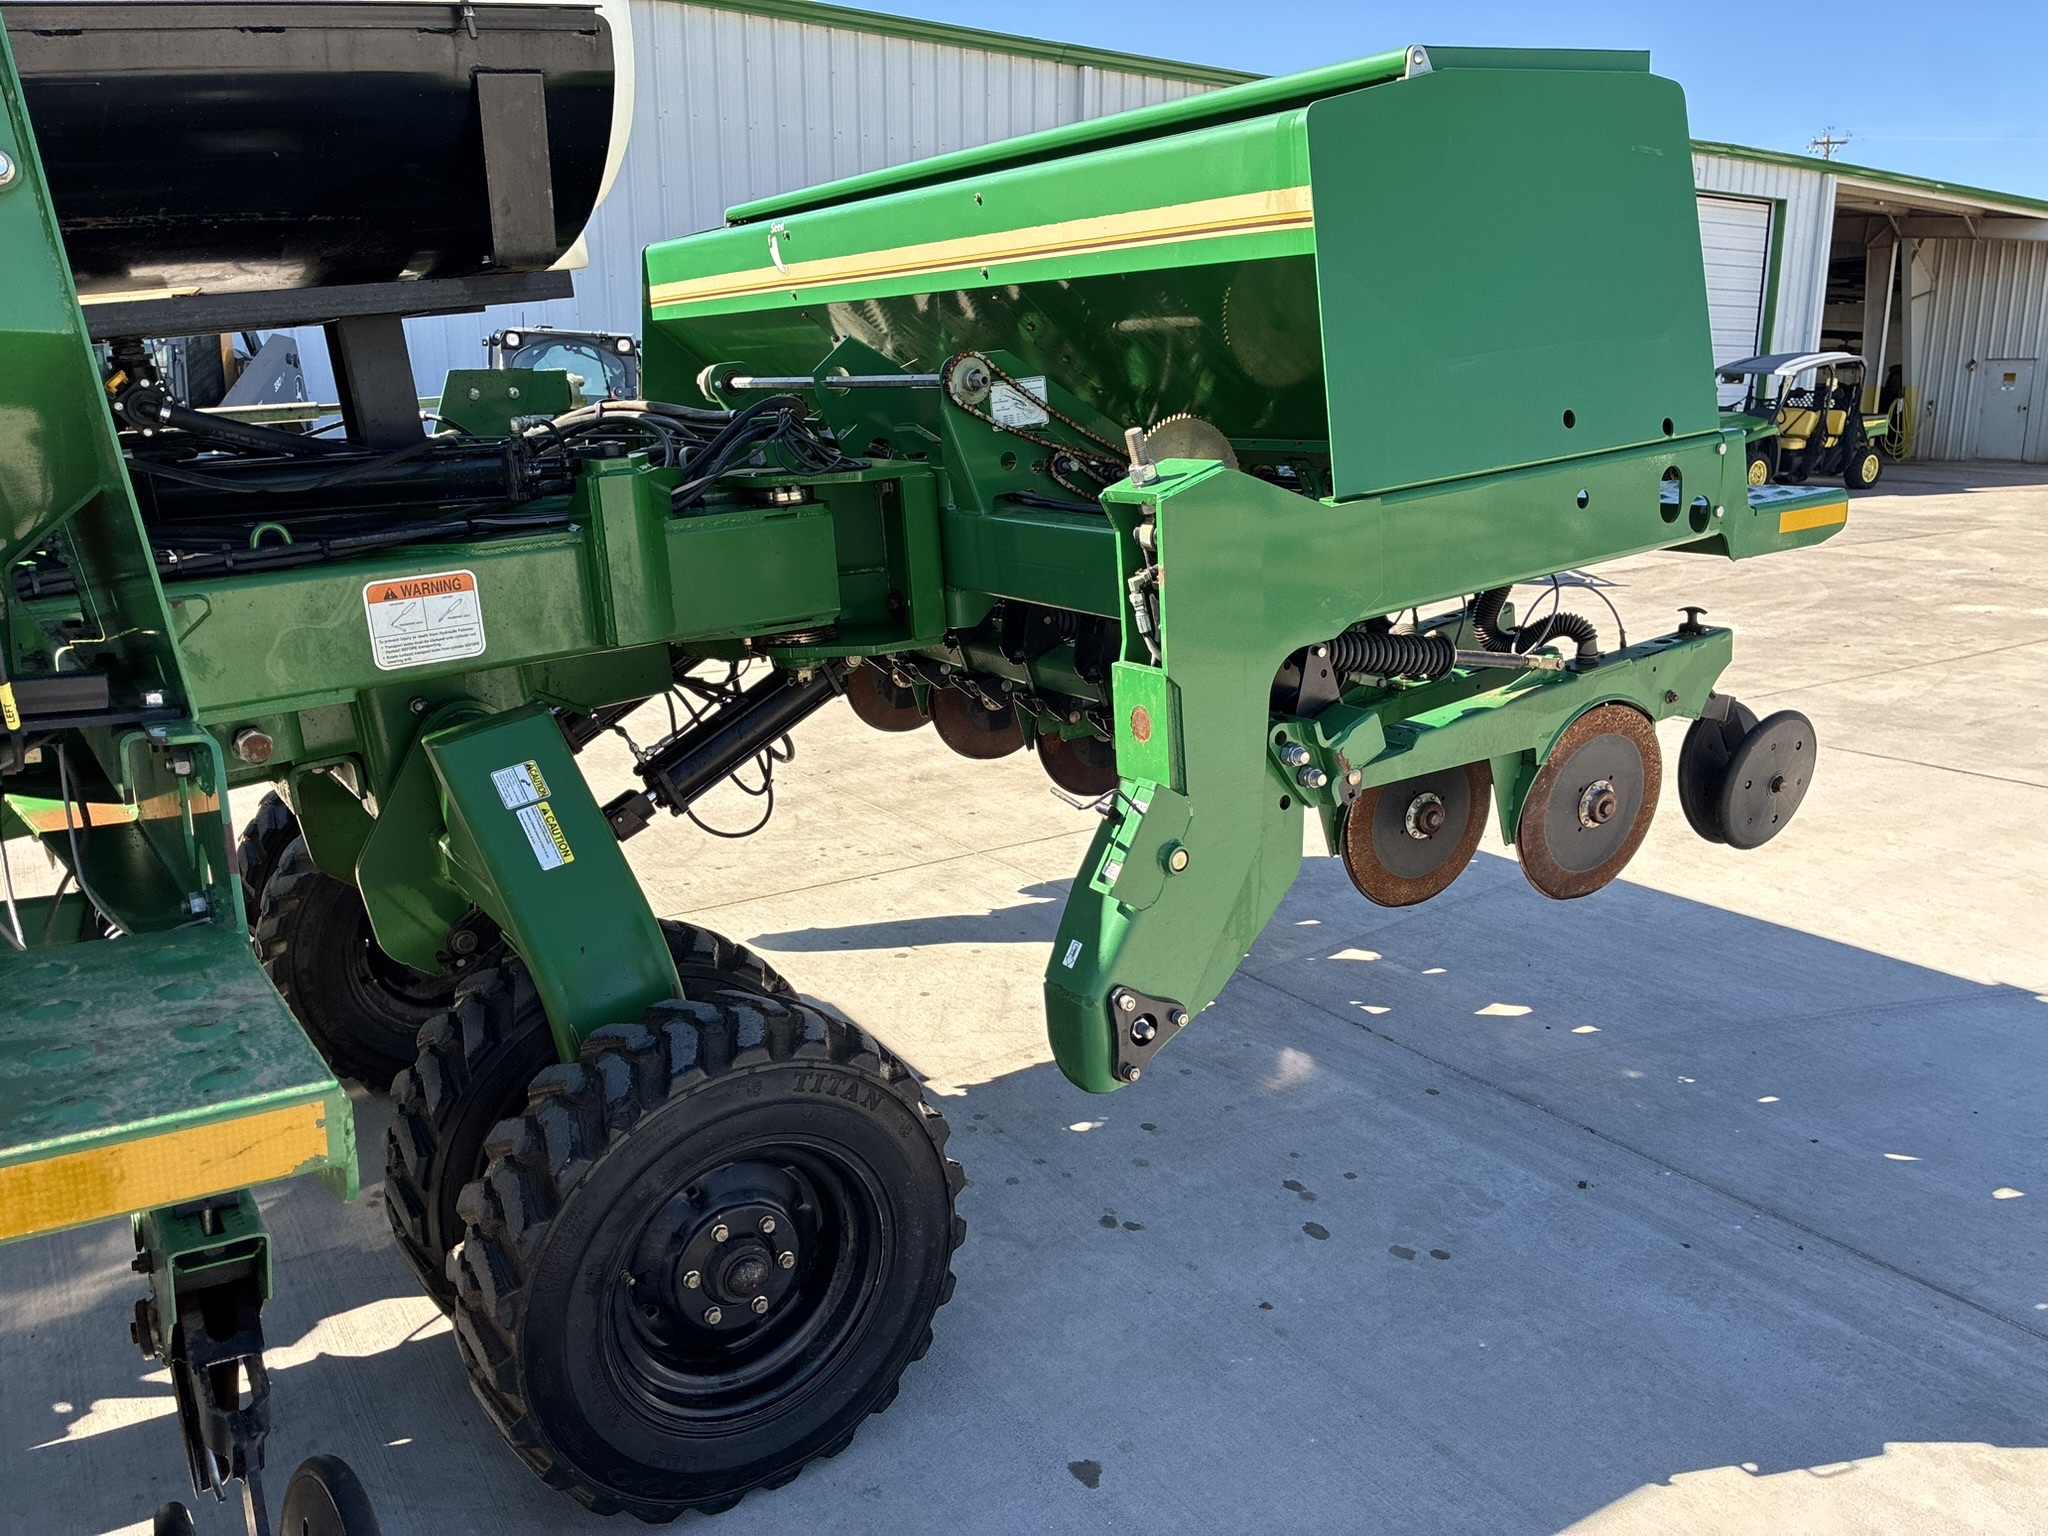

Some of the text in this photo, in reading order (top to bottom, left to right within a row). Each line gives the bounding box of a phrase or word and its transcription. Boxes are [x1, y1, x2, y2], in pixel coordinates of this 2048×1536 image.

[770, 219, 785, 233] Seed
[400, 577, 462, 598] WARNING
[3, 703, 16, 724] LEFT
[529, 767, 548, 797] CAUTION
[545, 815, 571, 857] CAUTION
[793, 1071, 886, 1111] TITAN
